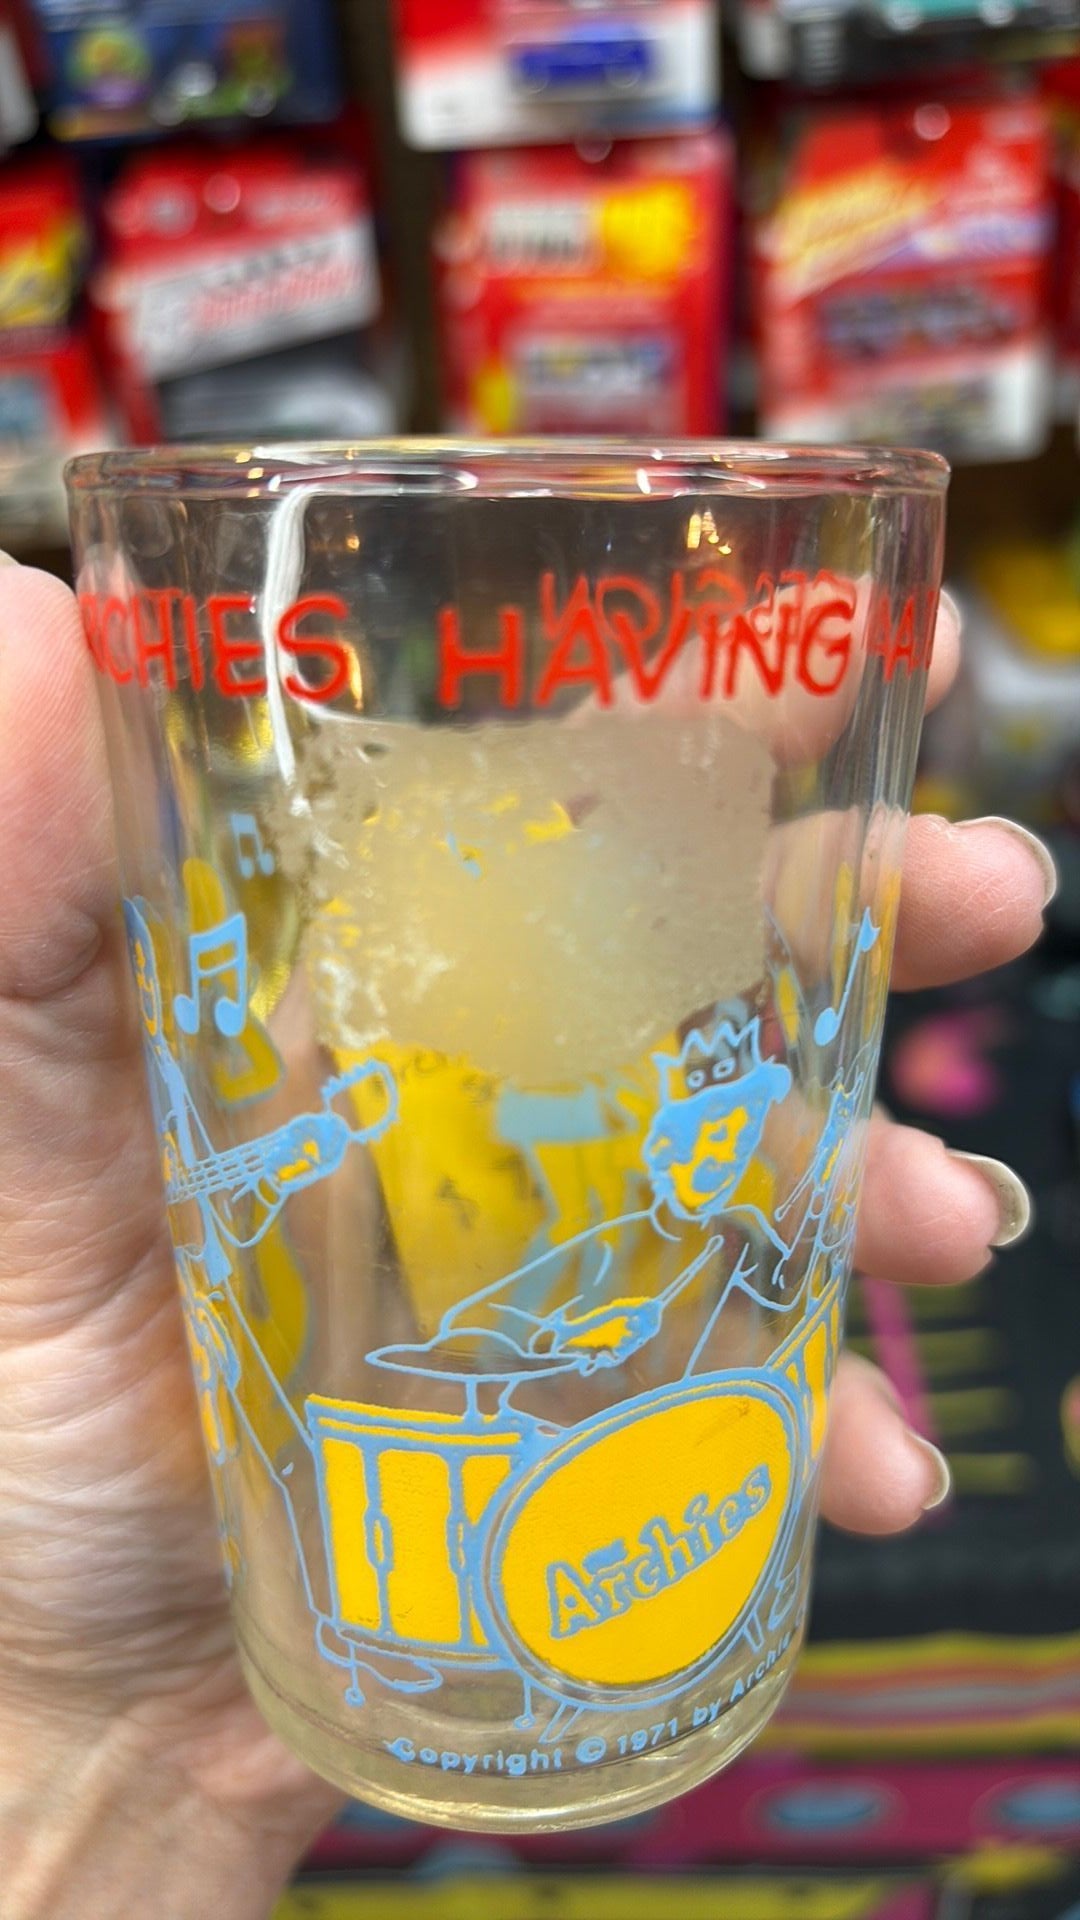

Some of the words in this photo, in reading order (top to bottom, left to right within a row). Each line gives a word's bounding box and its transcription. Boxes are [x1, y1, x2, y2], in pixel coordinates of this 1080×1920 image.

[437, 599, 853, 709] HAVING
[546, 1462, 773, 1640] Archies
[384, 1736, 562, 1775] Copyright
[616, 1717, 679, 1755] 1971
[692, 1697, 722, 1727] by
